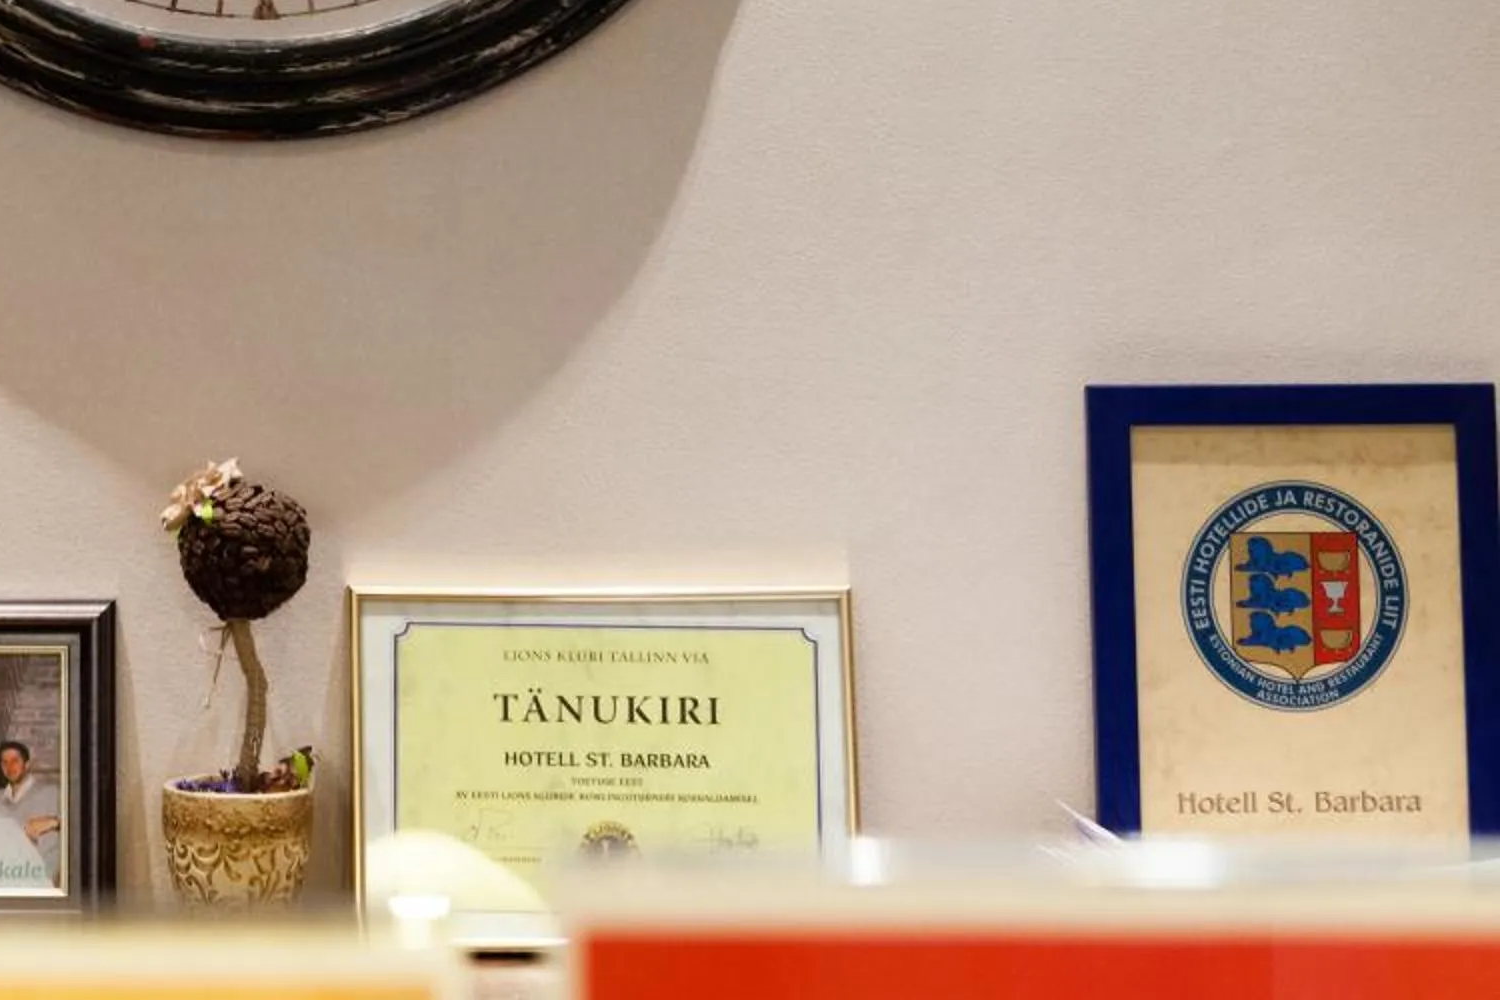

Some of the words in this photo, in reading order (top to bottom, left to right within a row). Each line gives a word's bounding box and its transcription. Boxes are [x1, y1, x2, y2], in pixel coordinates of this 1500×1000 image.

[1275, 490, 1298, 506] JA
[1194, 494, 1269, 574] HOTELLIDE
[1303, 490, 1399, 590] RESTORANIDE
[1188, 579, 1209, 630] EESTI
[493, 688, 720, 725] TÄNUKIRI
[504, 751, 580, 768] HOTELL
[585, 752, 614, 768] ST.
[620, 753, 711, 769] BARBARA
[1177, 791, 1259, 815] Hotell
[1267, 790, 1303, 814] St.
[1314, 790, 1423, 814] Barbara
